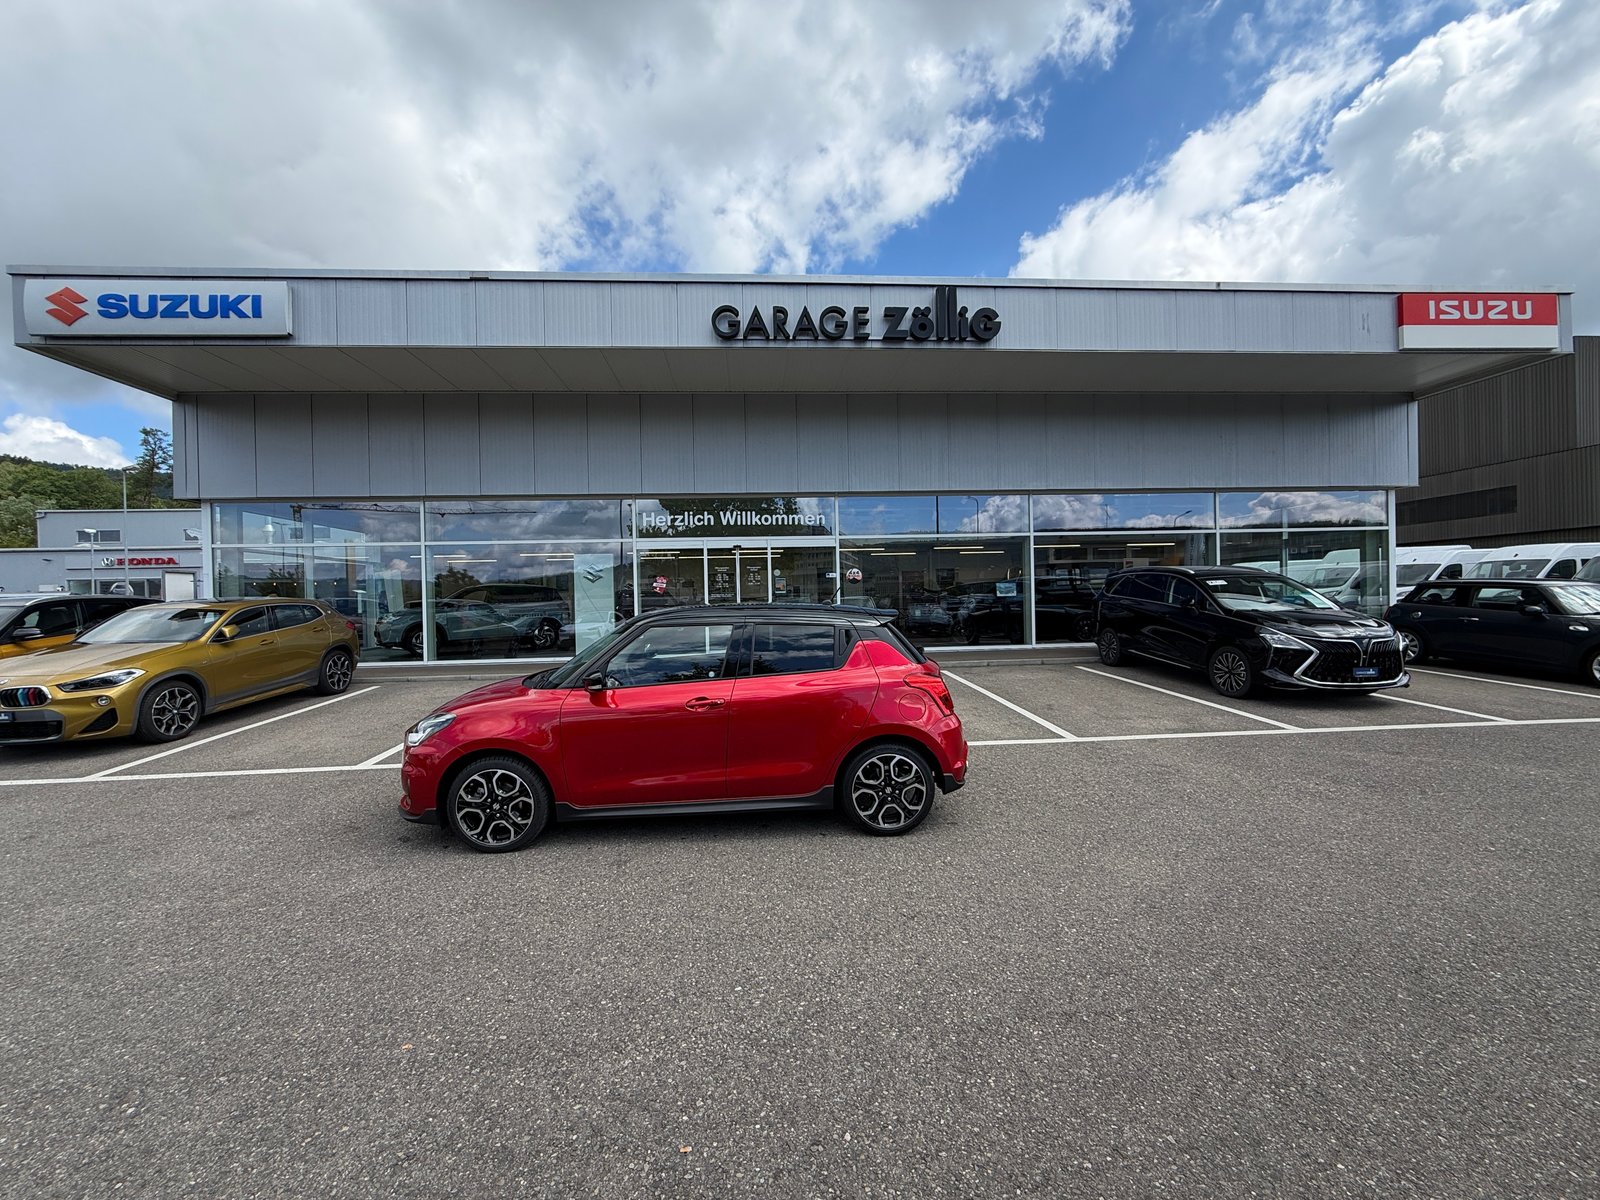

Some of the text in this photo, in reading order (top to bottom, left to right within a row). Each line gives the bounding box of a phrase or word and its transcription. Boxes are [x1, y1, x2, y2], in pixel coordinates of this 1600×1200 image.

[97, 293, 263, 319] SUZUKI
[1428, 300, 1533, 320] ISUZU
[711, 304, 871, 341] GARAGE
[642, 511, 826, 527] Herzlich Willkommen
[116, 557, 178, 566] HONDA
